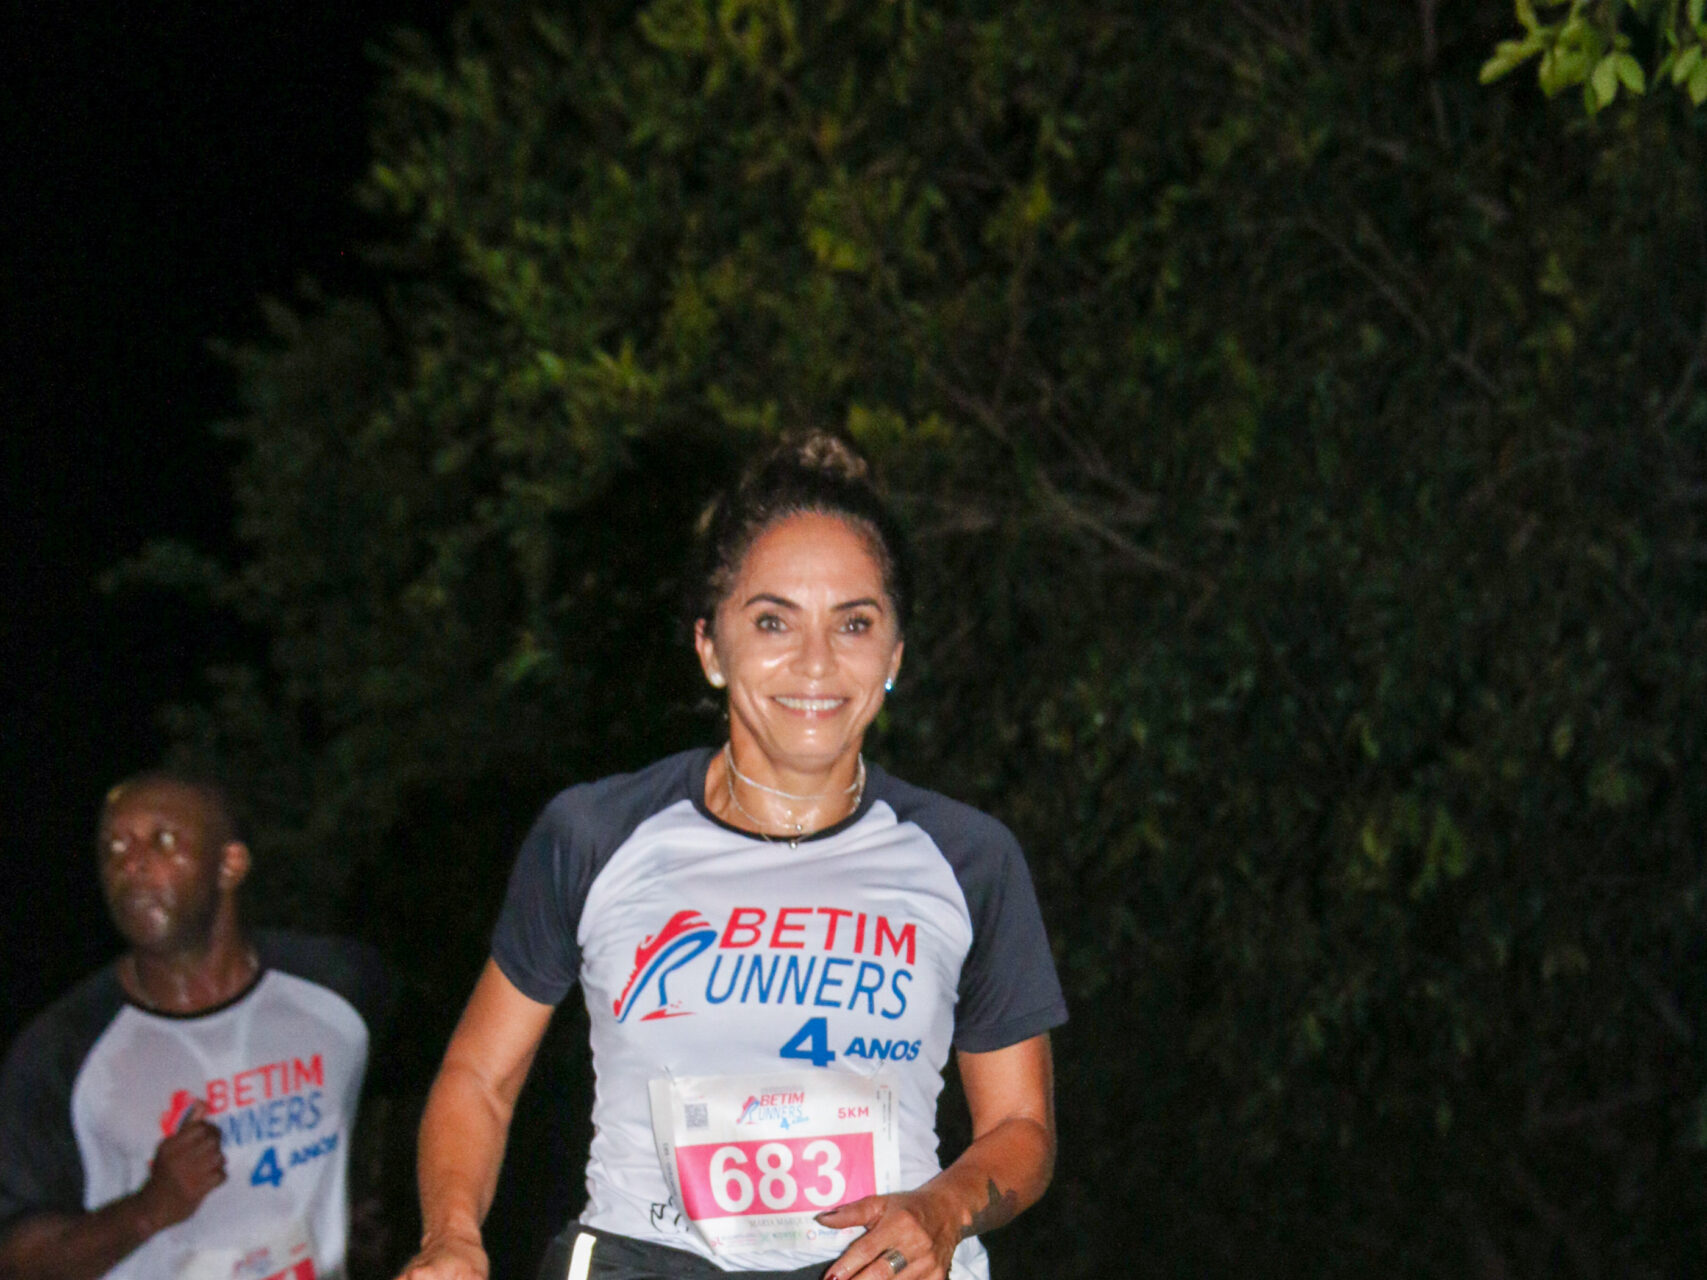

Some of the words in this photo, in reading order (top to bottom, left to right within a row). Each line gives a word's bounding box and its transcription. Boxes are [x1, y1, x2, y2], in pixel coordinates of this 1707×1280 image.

[719, 907, 917, 965] BETIM
[780, 1016, 836, 1068] 4
[843, 1036, 922, 1062] ANOS
[206, 1053, 324, 1115] BETIM
[760, 1092, 805, 1107] BETIM
[837, 1106, 869, 1120] 5KM
[251, 1146, 284, 1188] 4
[709, 1139, 847, 1213] 683
